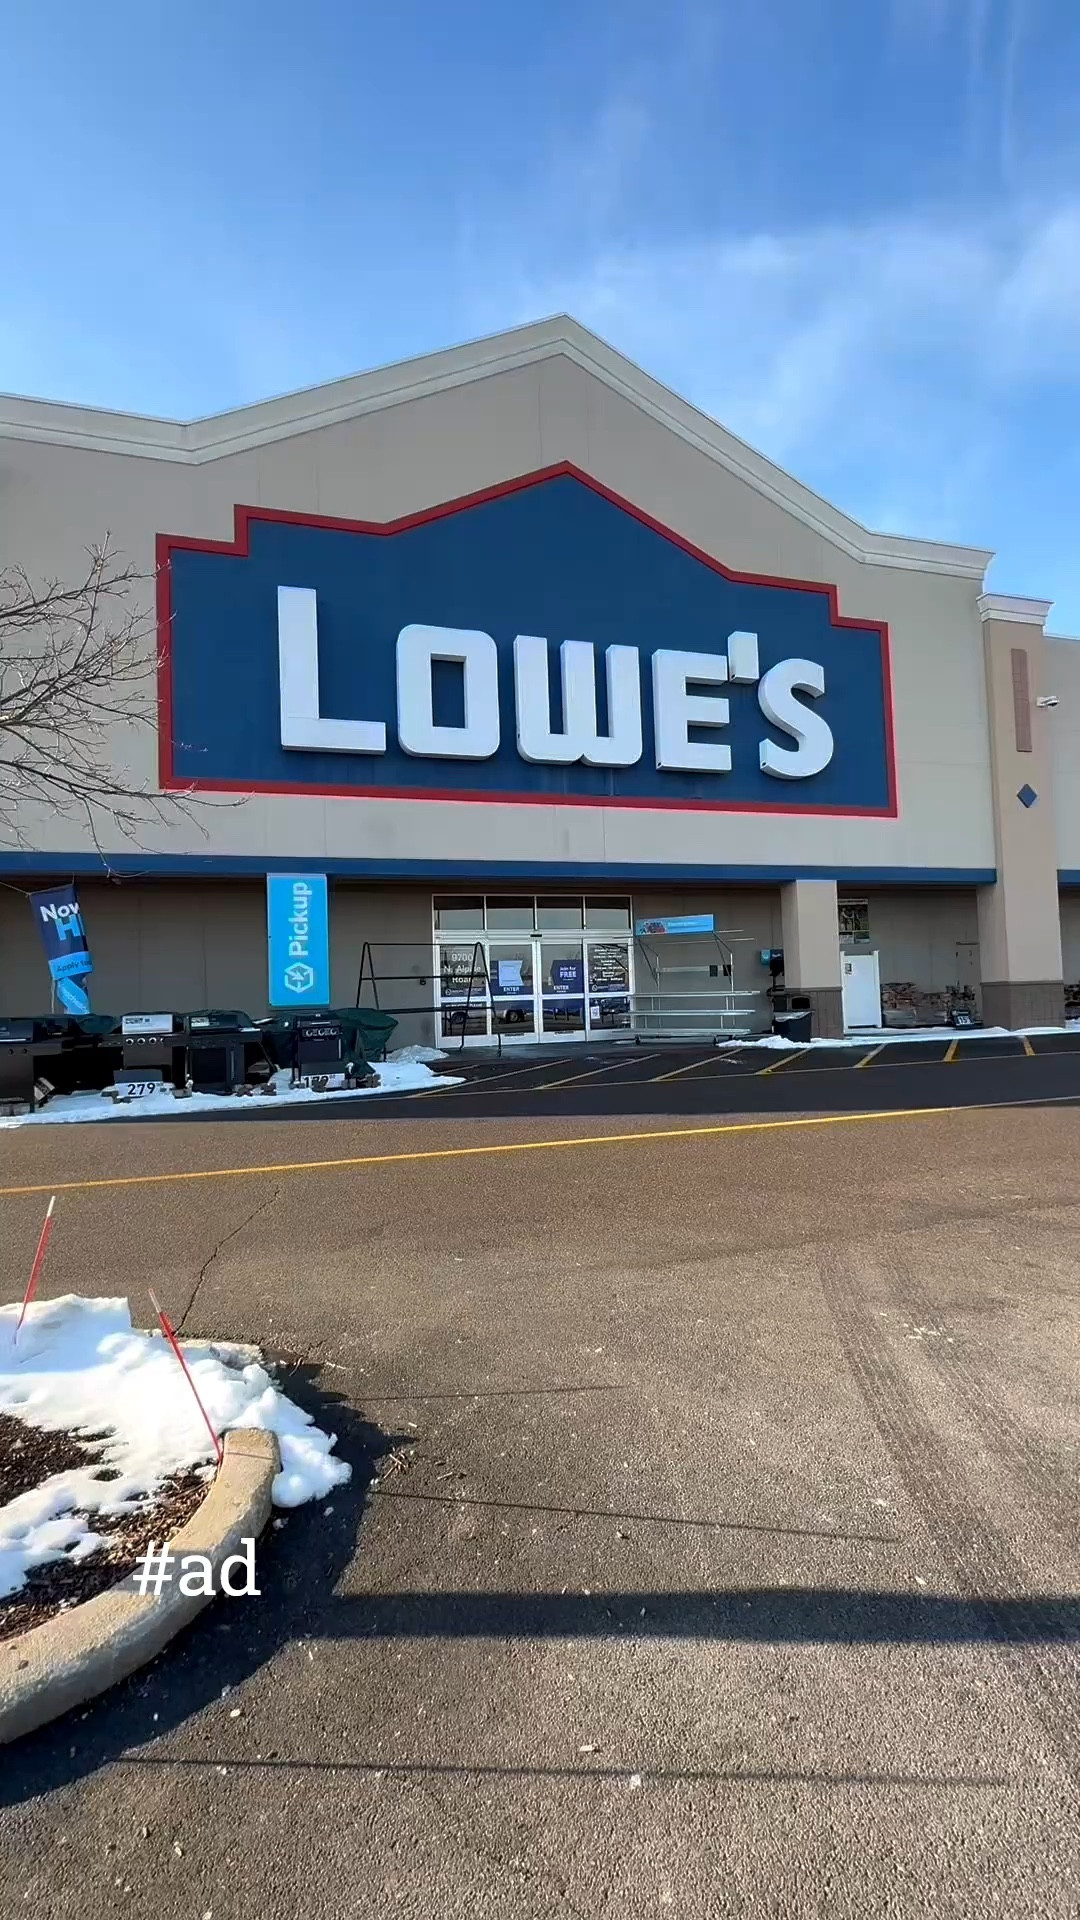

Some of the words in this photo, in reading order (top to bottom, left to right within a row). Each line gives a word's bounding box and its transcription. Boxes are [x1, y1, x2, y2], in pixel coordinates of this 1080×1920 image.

[277, 585, 834, 780] LOWE'S
[288, 882, 313, 956] Pickup
[451, 953, 474, 962] 9700
[57, 961, 80, 973] Apply
[443, 965, 453, 974] N.
[127, 1083, 156, 1096] 279
